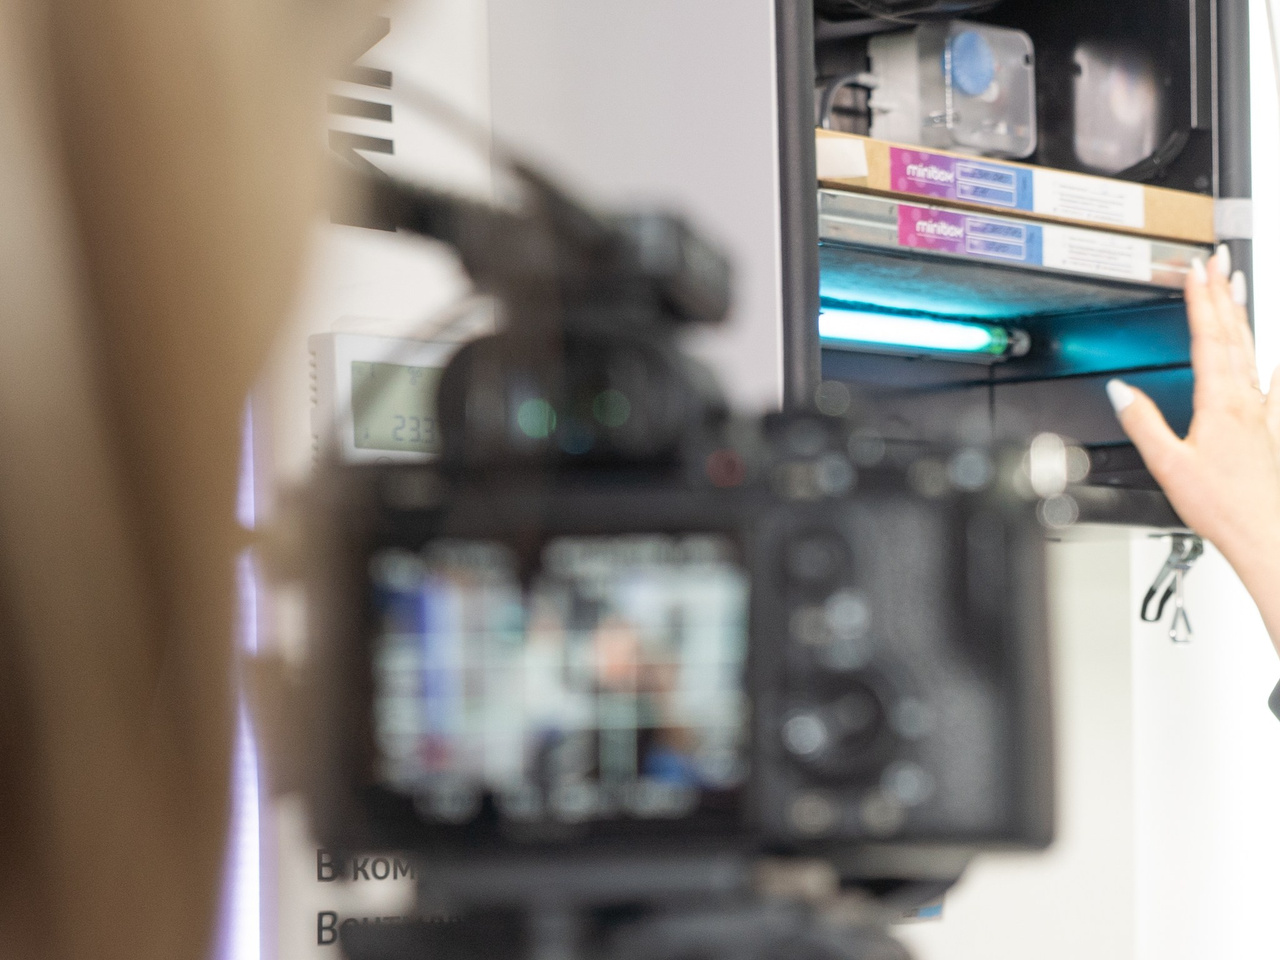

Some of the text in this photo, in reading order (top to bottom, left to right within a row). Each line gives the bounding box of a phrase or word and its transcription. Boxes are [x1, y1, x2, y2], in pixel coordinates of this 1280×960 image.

[905, 163, 955, 185] minibox
[915, 220, 964, 240] minibox
[316, 849, 417, 882] В ком
